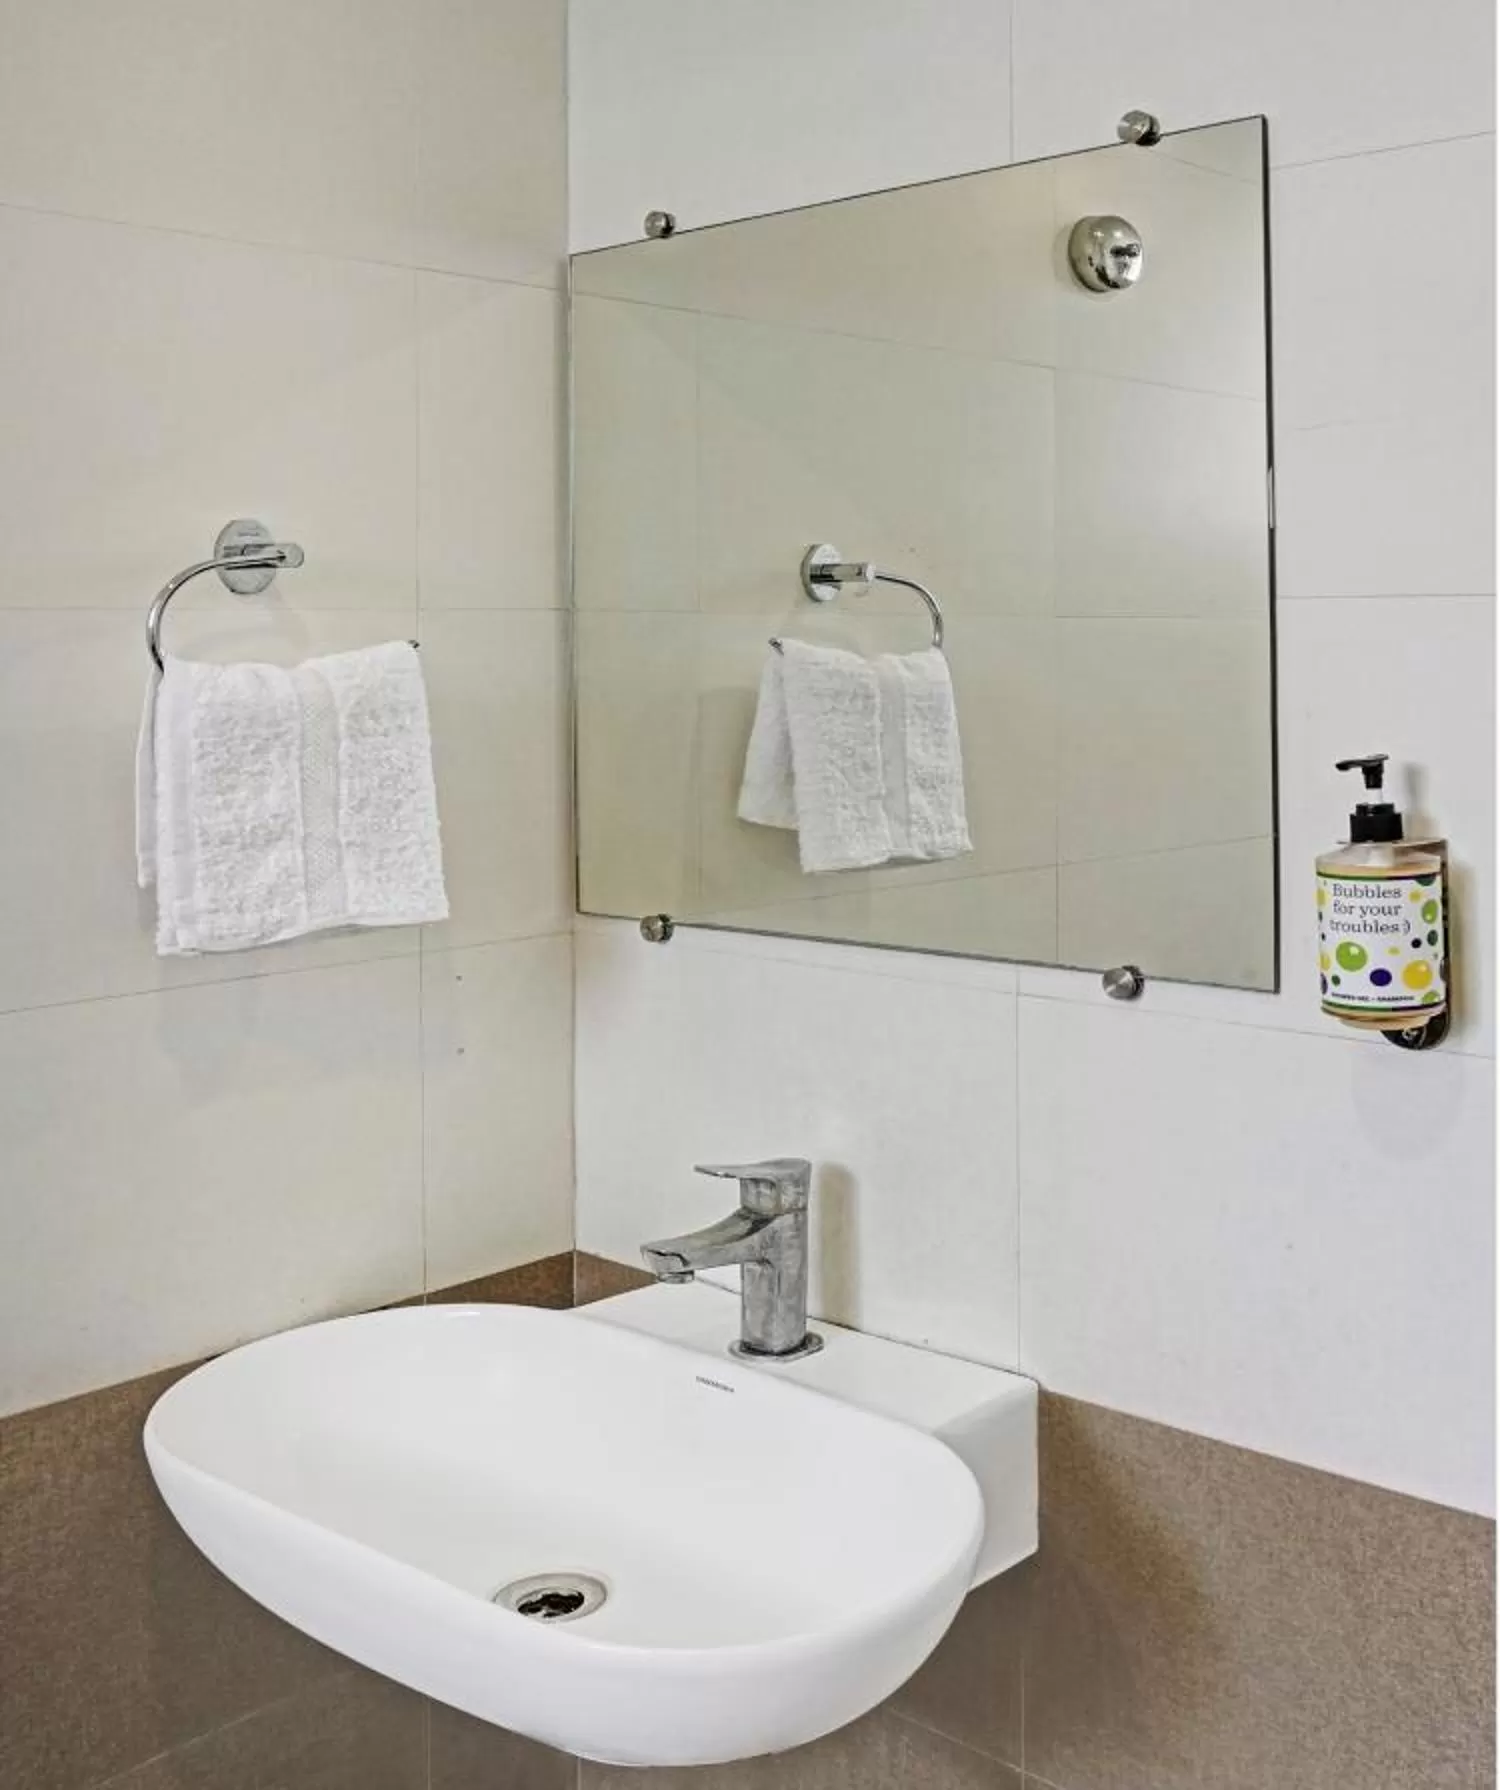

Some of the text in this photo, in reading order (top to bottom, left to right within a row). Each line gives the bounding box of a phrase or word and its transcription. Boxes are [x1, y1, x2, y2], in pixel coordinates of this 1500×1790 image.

[1332, 883, 1402, 899] Bubbles
[1333, 899, 1403, 919] for your
[1329, 919, 1400, 934] troubles
